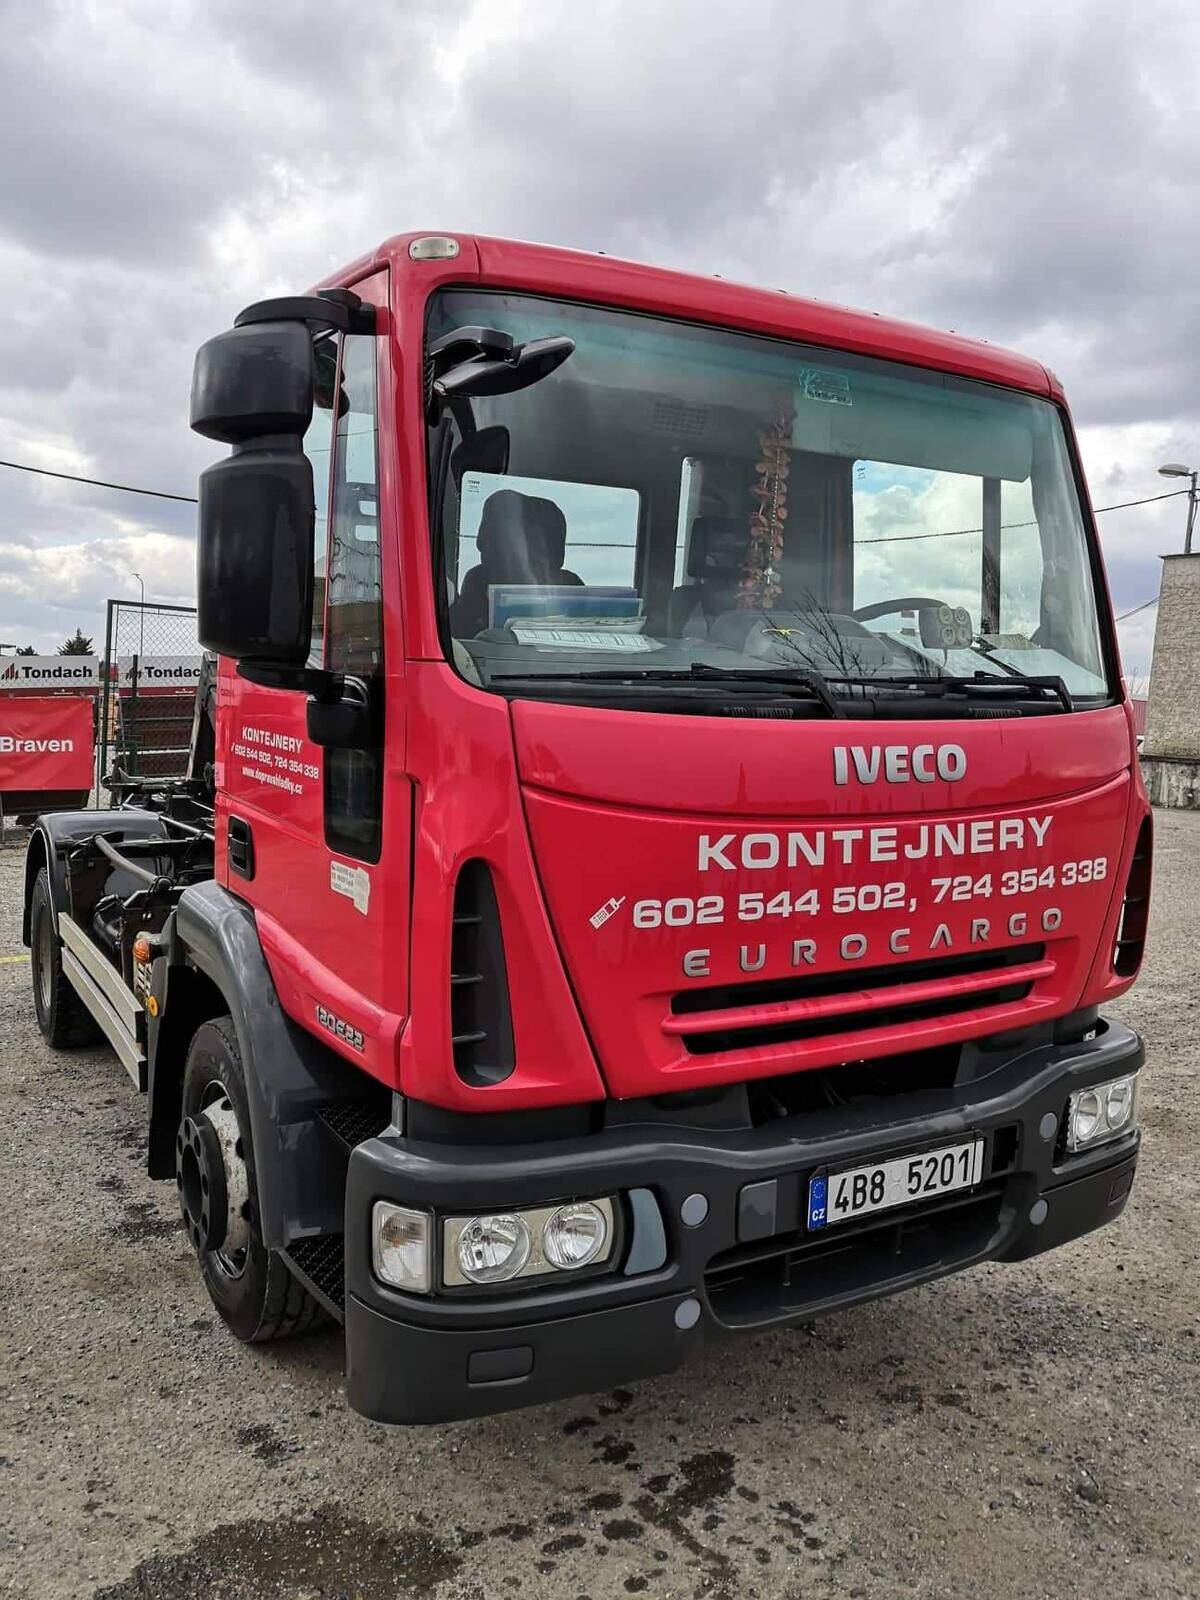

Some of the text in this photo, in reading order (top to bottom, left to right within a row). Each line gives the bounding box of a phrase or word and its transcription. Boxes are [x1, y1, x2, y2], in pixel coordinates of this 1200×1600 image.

[22, 666, 93, 678] Tondach
[145, 667, 200, 678] Tondac
[0, 737, 73, 752] Braven
[242, 726, 302, 754] KONTEJNERY
[235, 744, 246, 757] 602
[246, 747, 258, 760] 544
[274, 754, 288, 769] 724
[288, 759, 303, 774] 354
[303, 765, 319, 779] 338
[833, 744, 967, 785] IVECO
[698, 815, 1054, 871] KONTEJNERY
[632, 857, 1108, 928] 602 544 502, 724 354 338
[683, 908, 1062, 977] EUROCARGO
[315, 1005, 364, 1051] 120E22
[834, 1149, 970, 1213] 4B8 5201
[812, 1208, 826, 1221] CZ
